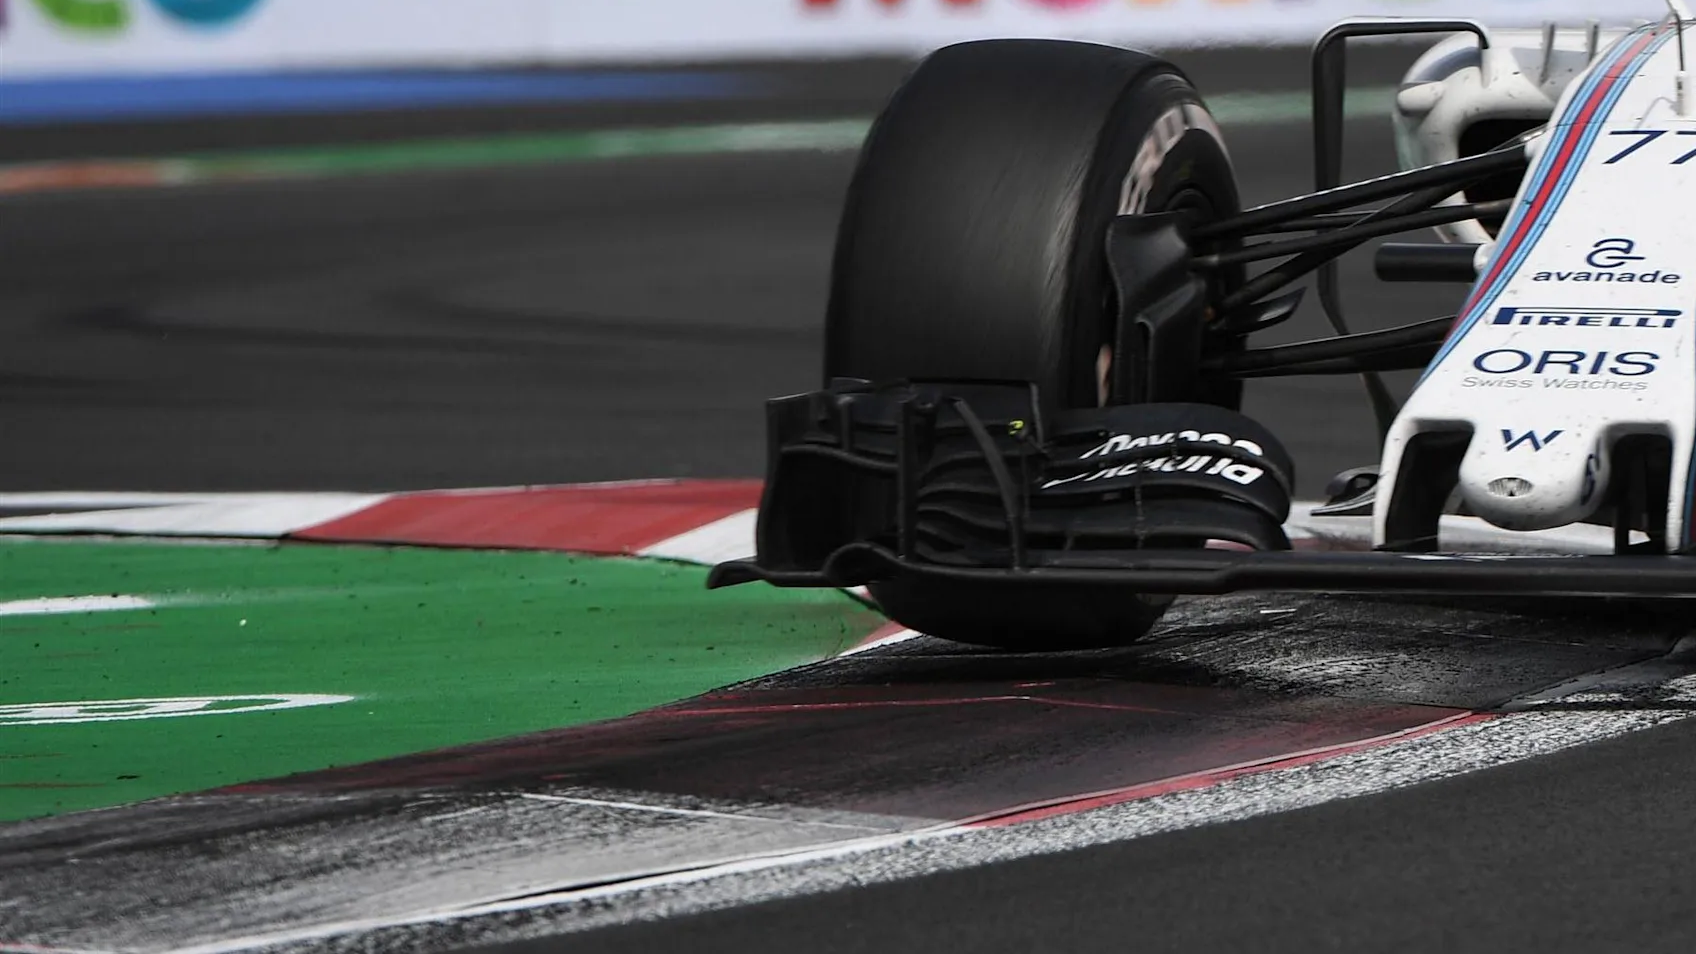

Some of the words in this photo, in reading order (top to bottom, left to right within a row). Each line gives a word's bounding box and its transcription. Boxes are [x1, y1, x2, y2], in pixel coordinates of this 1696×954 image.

[1533, 270, 1681, 284] avanade
[1492, 307, 1682, 328] PIRELLI
[1473, 349, 1660, 376] ORIS
[1462, 376, 1533, 388] Swiss
[1543, 377, 1648, 391] Watches
